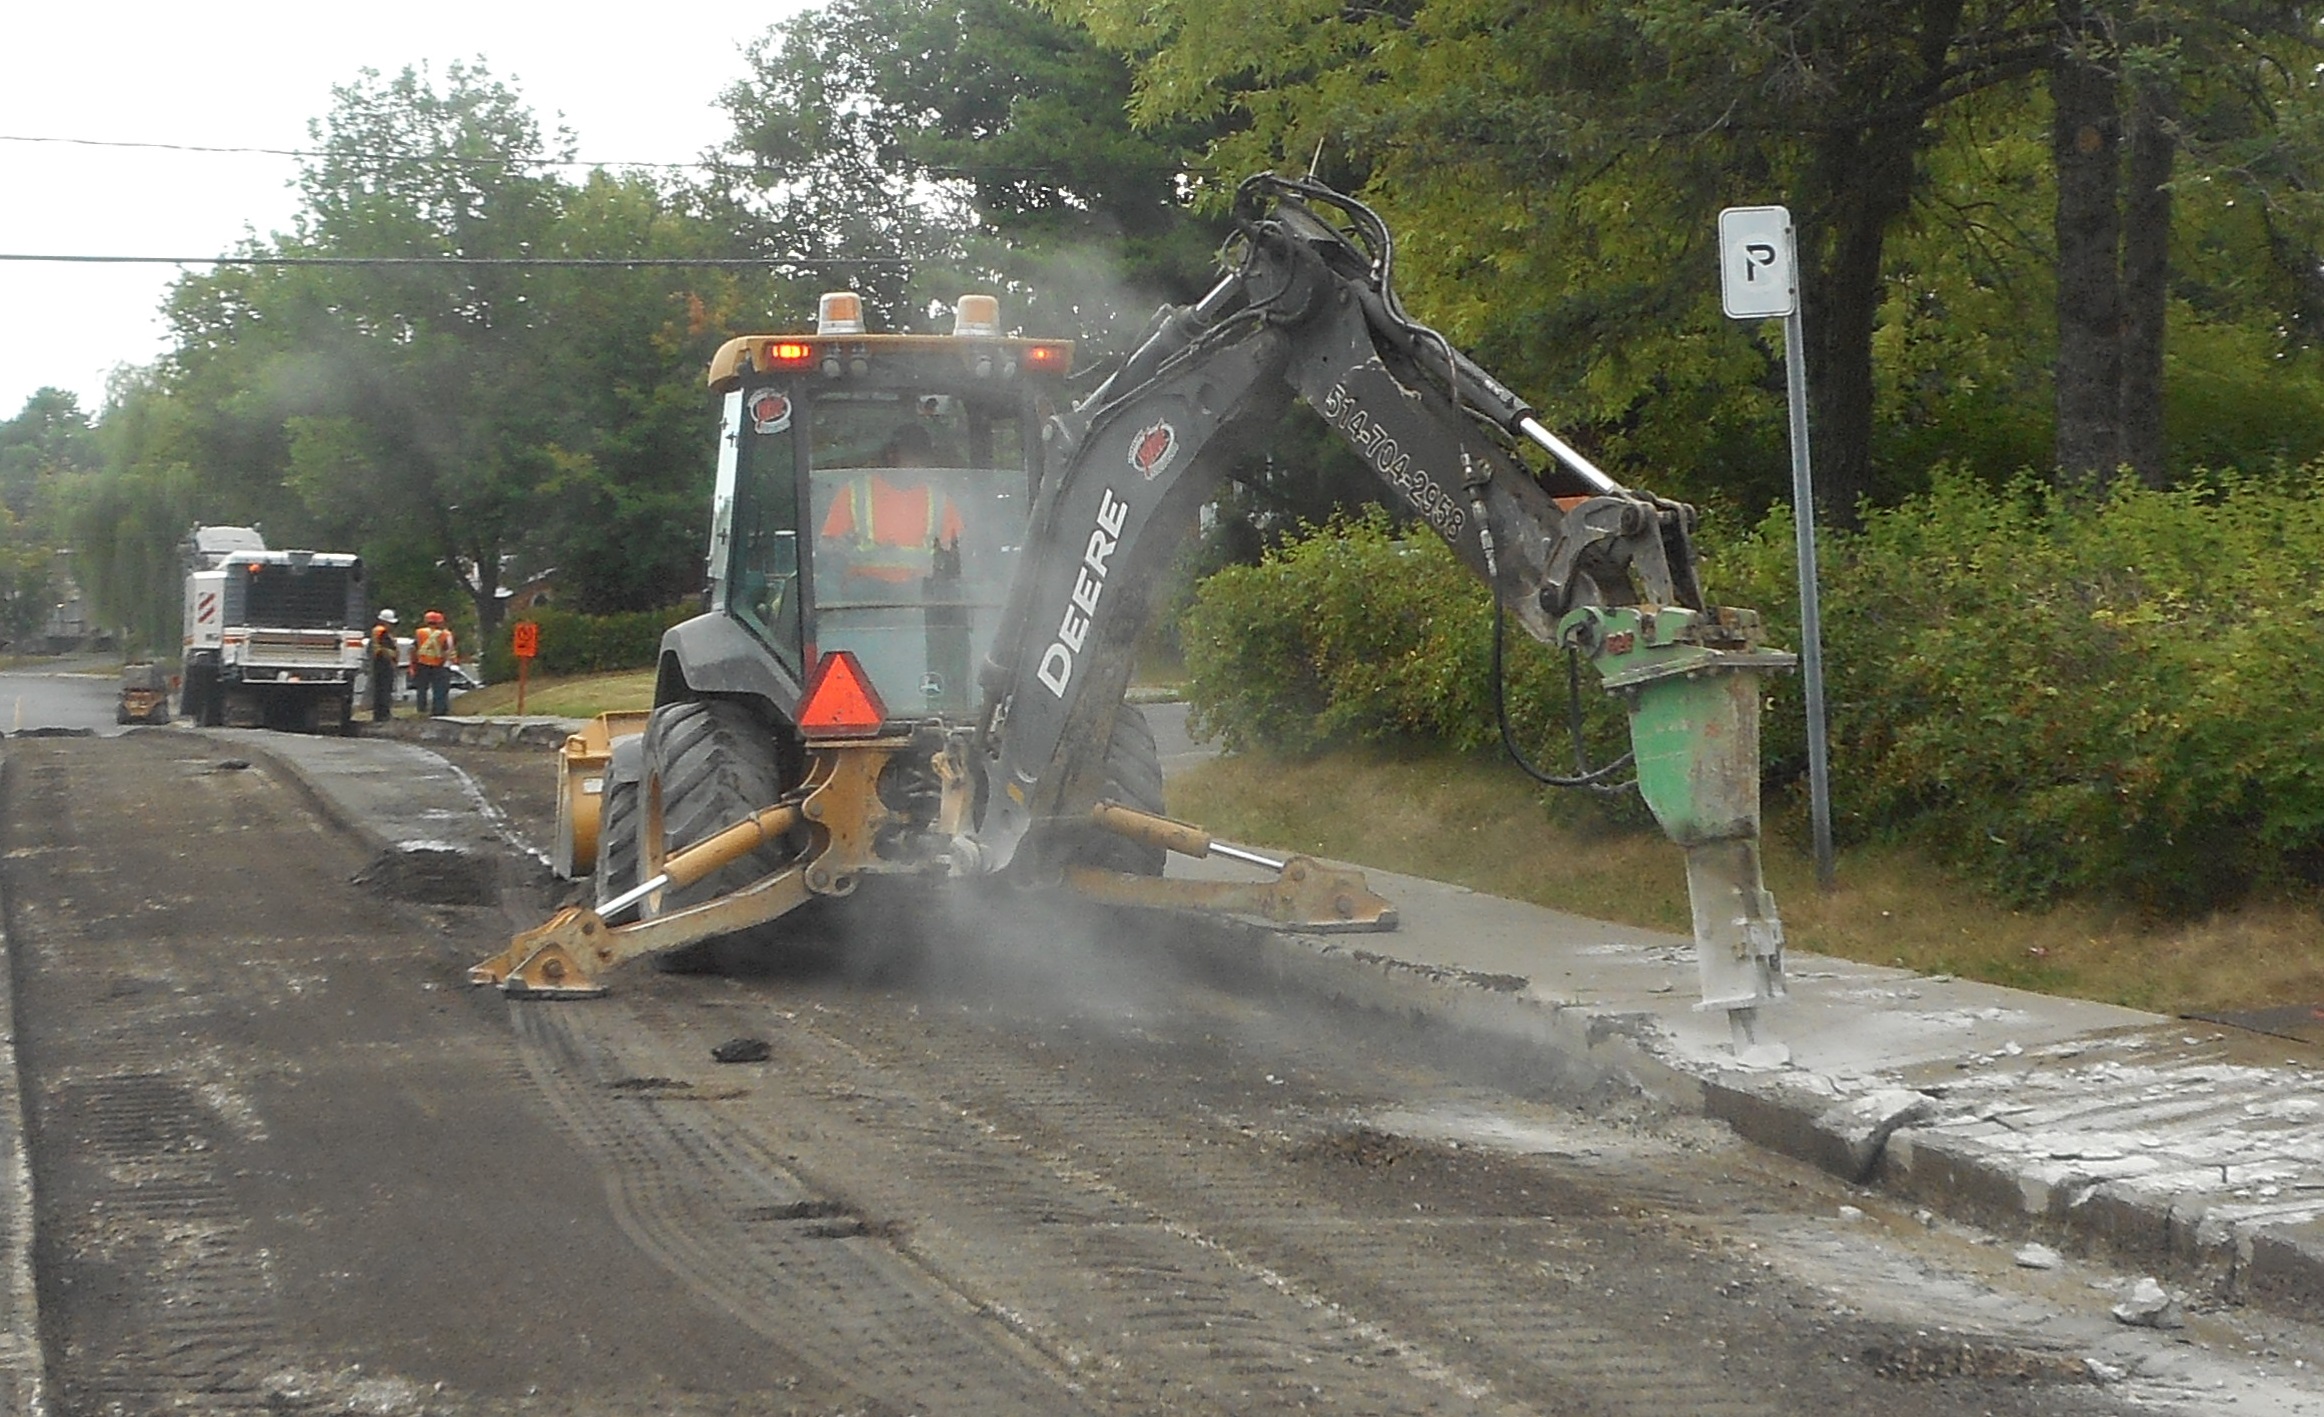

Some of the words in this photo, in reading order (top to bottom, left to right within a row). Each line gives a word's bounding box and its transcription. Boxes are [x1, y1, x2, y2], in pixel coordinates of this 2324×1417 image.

[1745, 244, 1776, 281] P
[1325, 384, 1465, 542] 514-704-2958
[1037, 488, 1128, 698] DEERE
